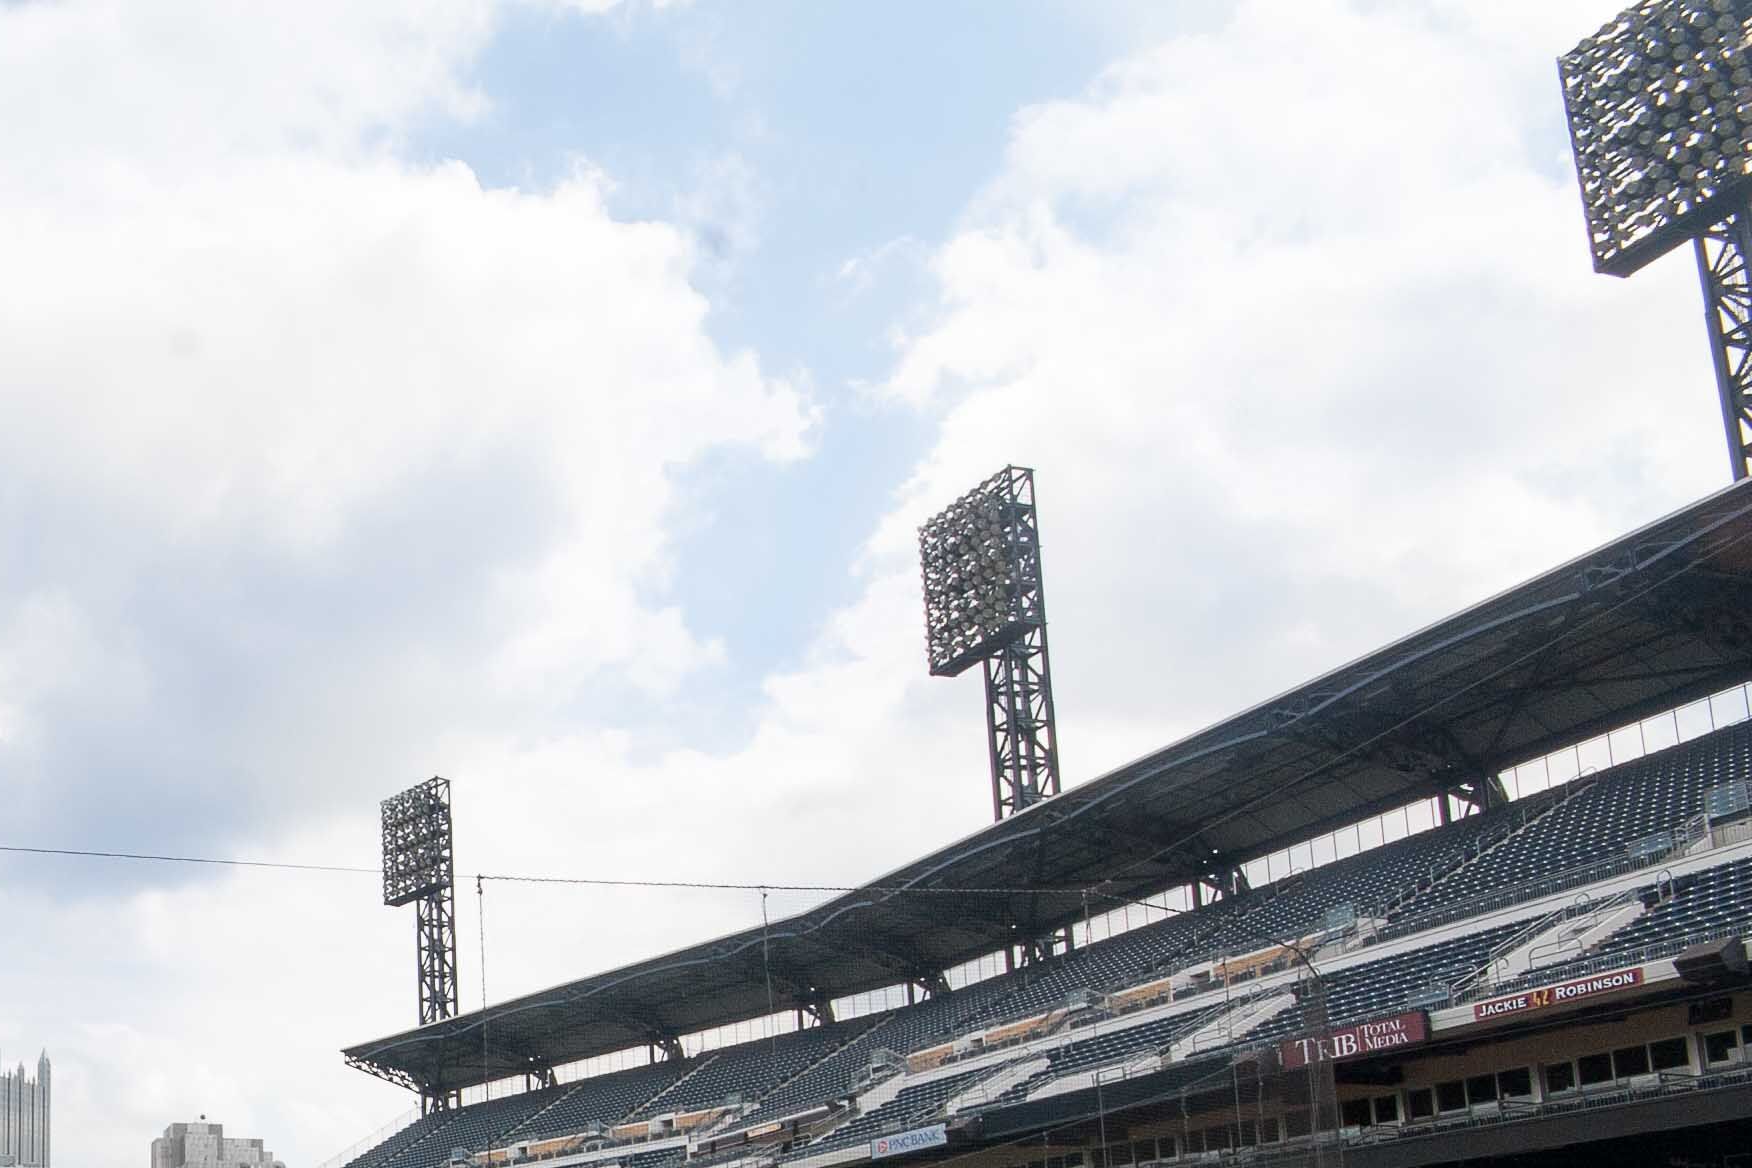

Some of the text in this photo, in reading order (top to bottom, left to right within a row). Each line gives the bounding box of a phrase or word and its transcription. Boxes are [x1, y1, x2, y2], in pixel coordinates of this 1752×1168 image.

[1479, 973, 1634, 1018] JACKIE 42 ROBINSON
[1361, 1018, 1406, 1038] TOTAL
[1296, 1033, 1357, 1065] TRIB
[1364, 1031, 1409, 1052] MEDIA
